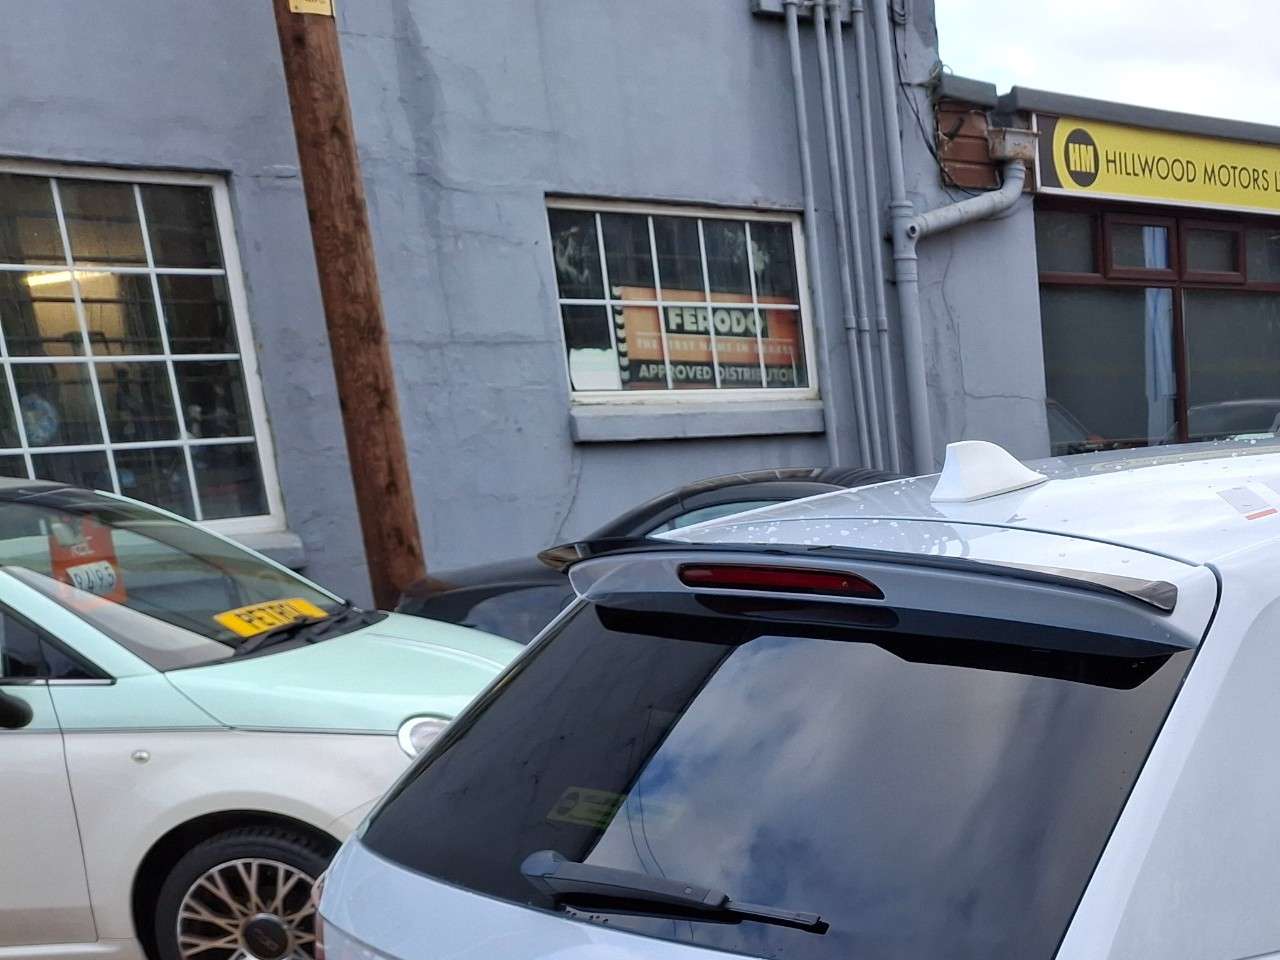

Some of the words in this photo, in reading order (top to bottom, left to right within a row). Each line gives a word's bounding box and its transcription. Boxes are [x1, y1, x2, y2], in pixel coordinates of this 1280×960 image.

[1105, 149, 1197, 184] HILLWOOD
[1203, 163, 1270, 192] MOTORS
[639, 364, 712, 380] APPROVED
